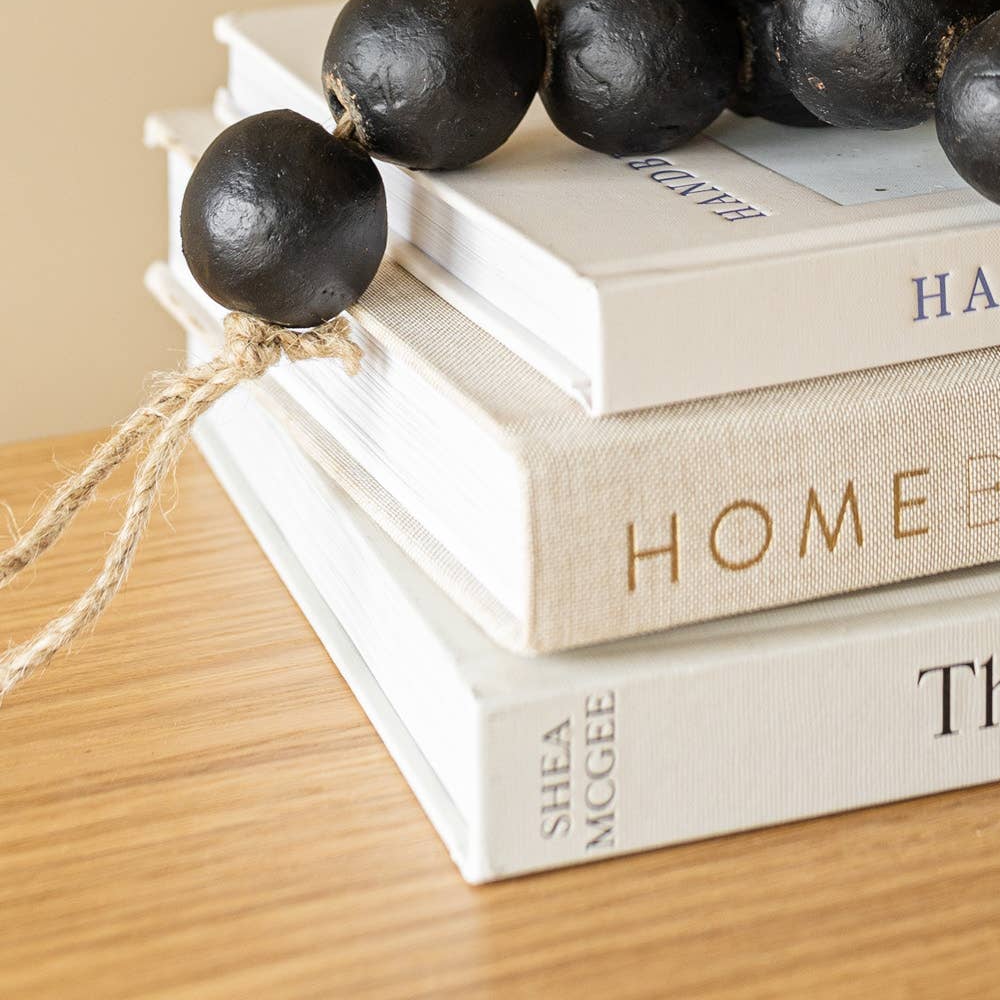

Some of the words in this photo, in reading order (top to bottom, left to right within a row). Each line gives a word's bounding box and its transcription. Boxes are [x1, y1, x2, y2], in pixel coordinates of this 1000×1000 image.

[613, 152, 767, 222] HANDB
[541, 718, 571, 840] SHEA
[584, 690, 616, 851] MCGEE
